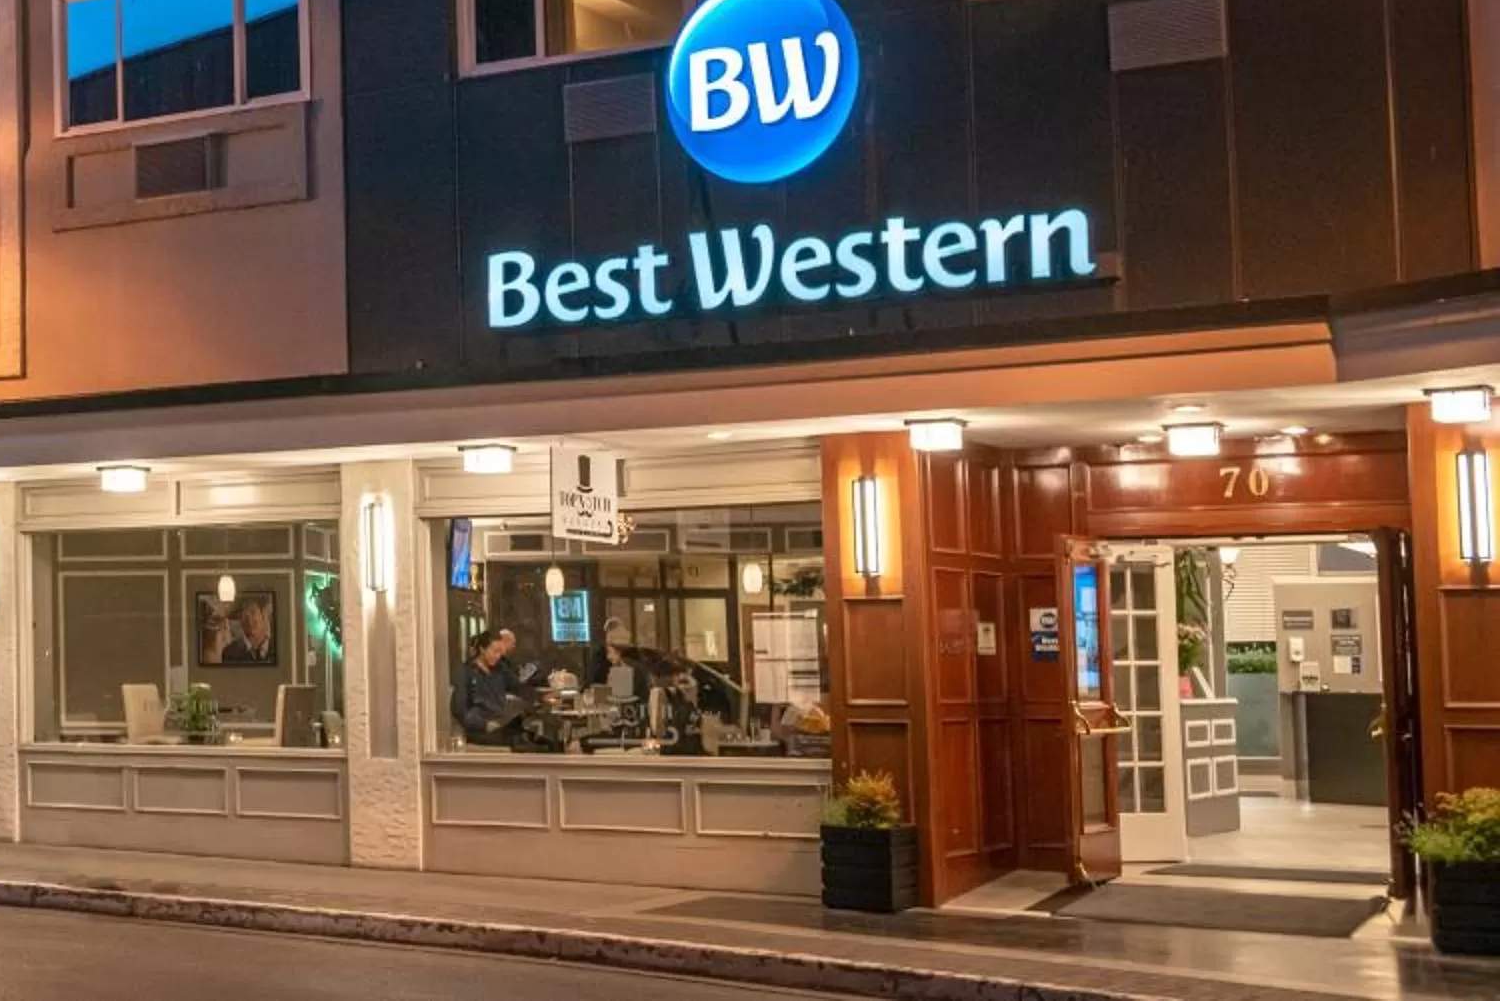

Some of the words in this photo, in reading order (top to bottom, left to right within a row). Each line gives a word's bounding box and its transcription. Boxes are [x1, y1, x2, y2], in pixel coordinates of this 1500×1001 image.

[688, 31, 840, 132] BW
[487, 244, 671, 328] Best
[688, 208, 1097, 309] Western
[1219, 467, 1269, 498] 70
